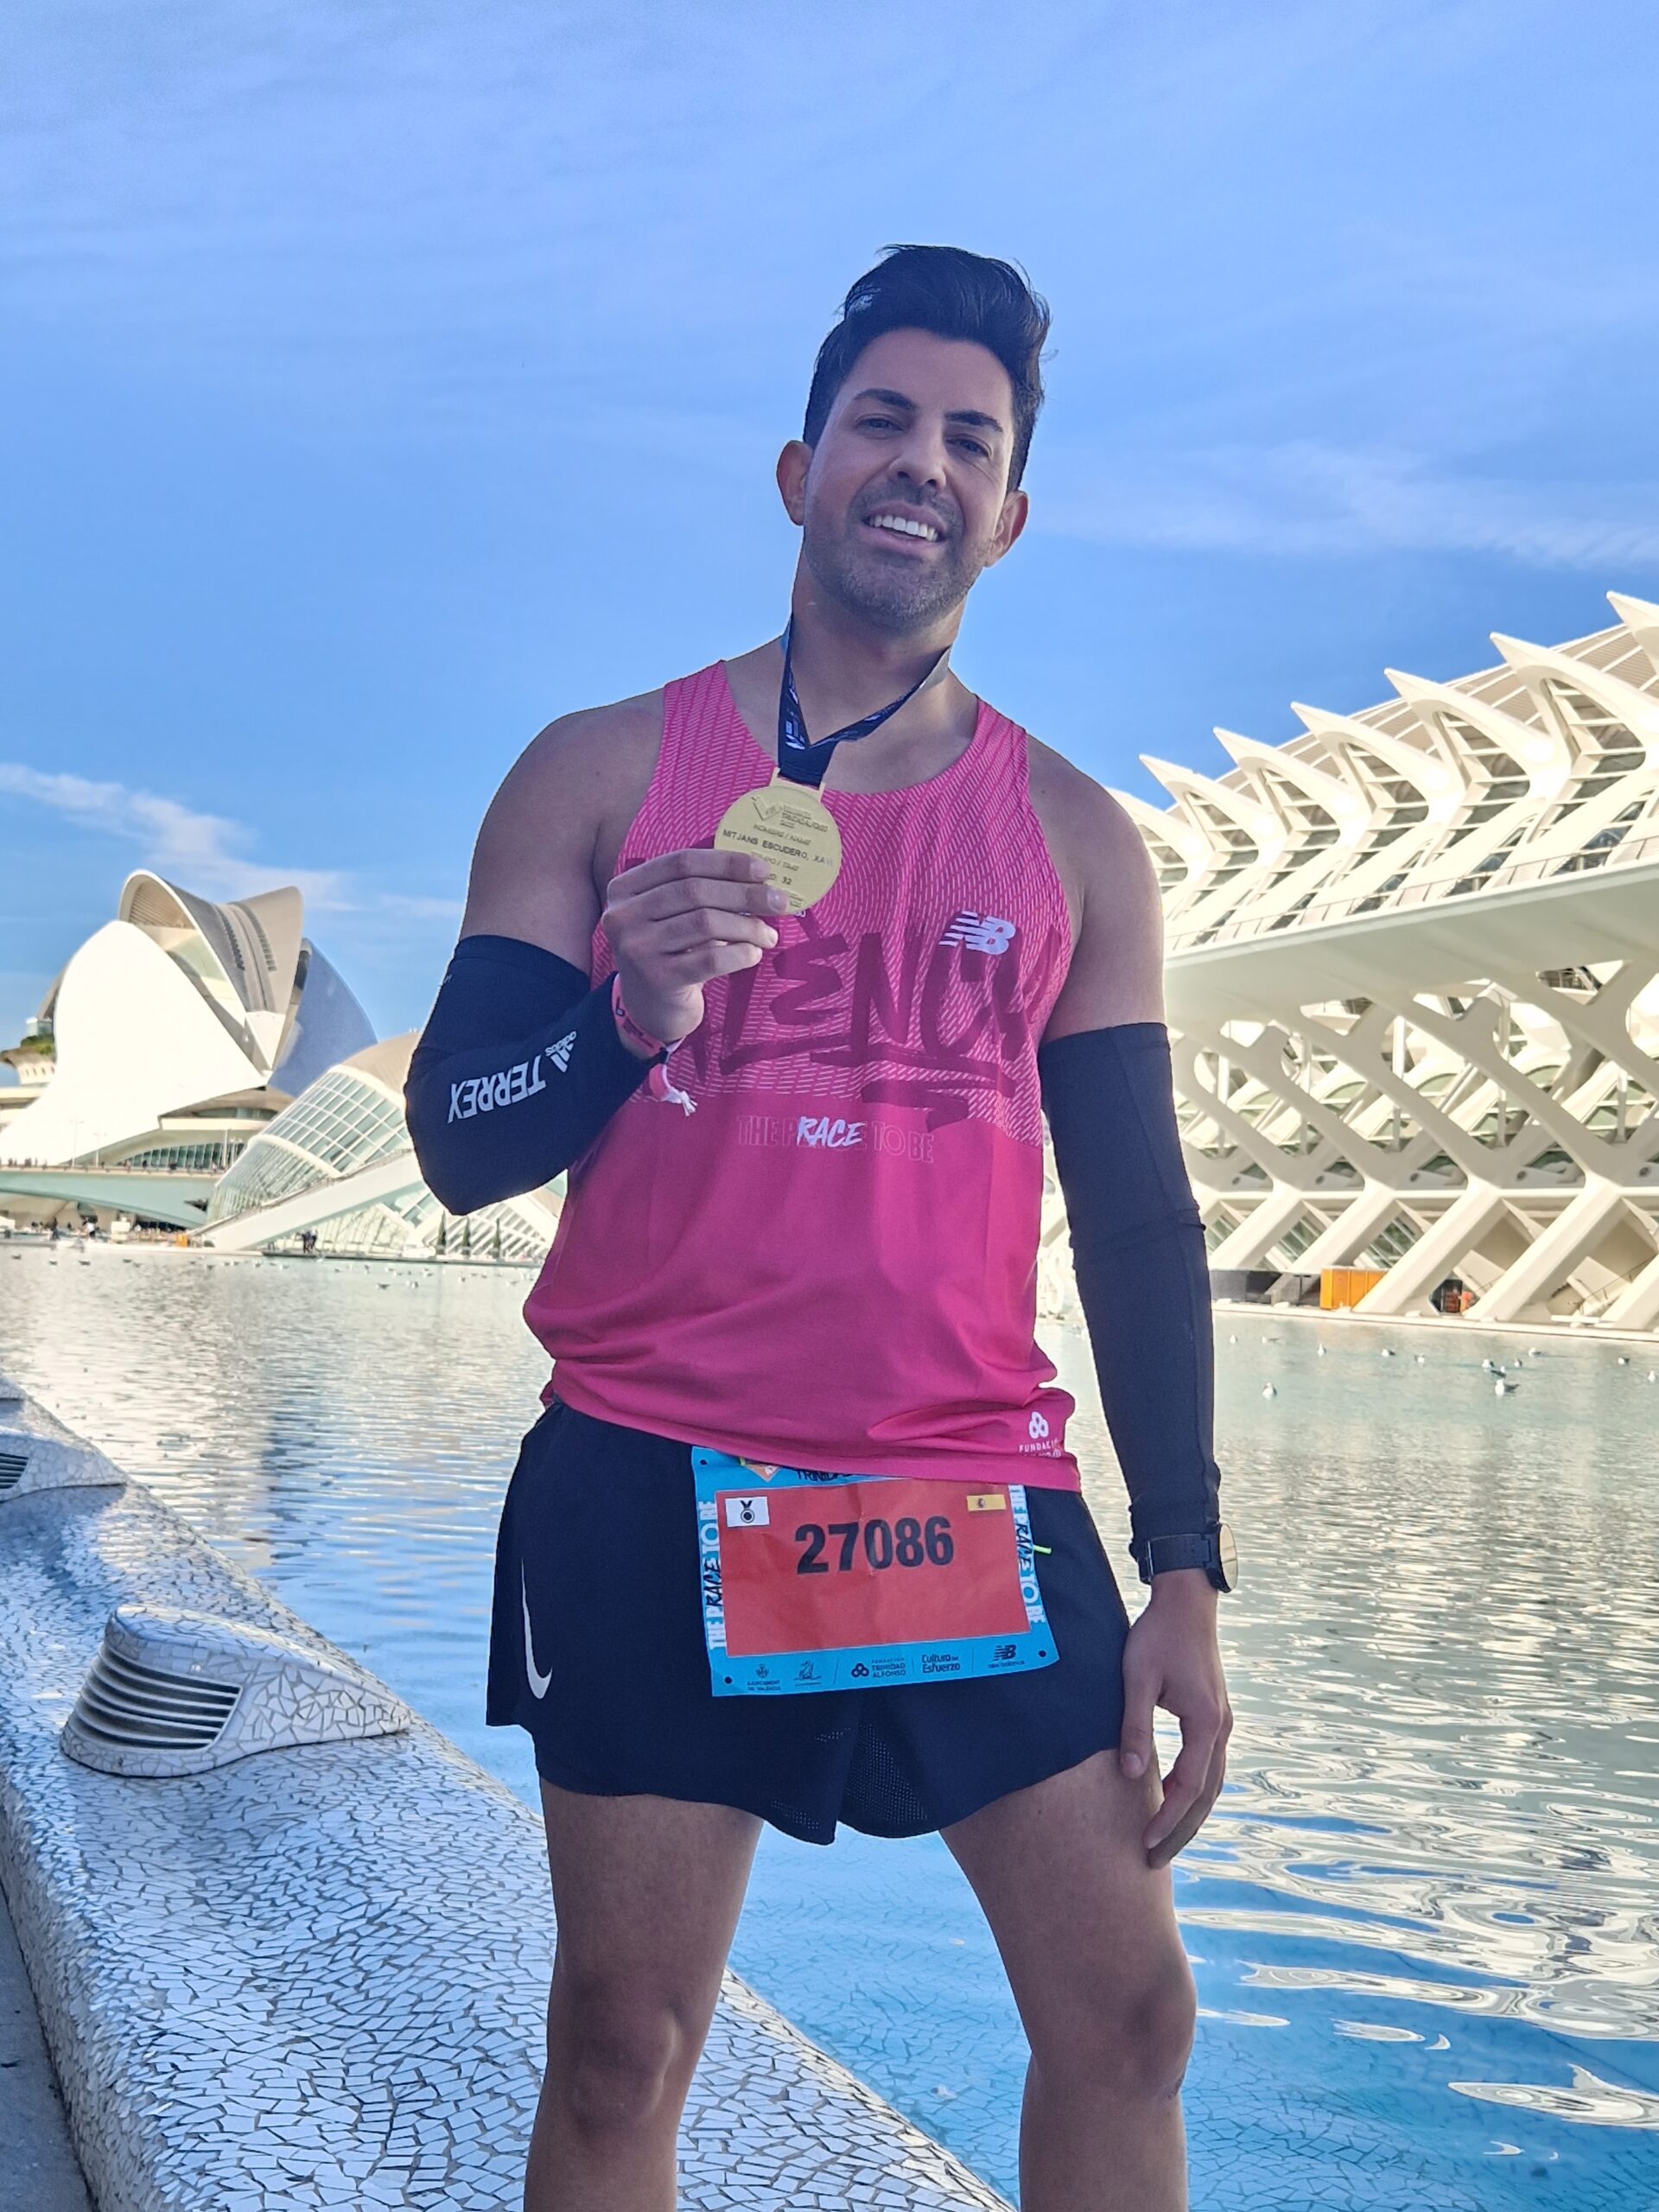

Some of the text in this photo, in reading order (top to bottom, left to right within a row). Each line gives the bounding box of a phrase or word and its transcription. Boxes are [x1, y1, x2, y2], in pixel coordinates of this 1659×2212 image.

[722, 829, 759, 845] MITJANS
[447, 1054, 547, 1124] TERREX
[796, 1116, 867, 1148] RACE
[871, 1121, 906, 1156] TO
[908, 1130, 934, 1164] BE
[700, 1522, 720, 1554] TO
[794, 1516, 954, 1575] 27086
[703, 1558, 723, 1607] RACE
[1019, 1573, 1040, 1605] TO
[707, 1621, 727, 1650] THE
[872, 1662, 906, 1671] TRINIDAD
[873, 1669, 906, 1678] ALFONSO
[922, 1654, 950, 1663] Cultura
[923, 1662, 961, 1673] Esfuerzo
